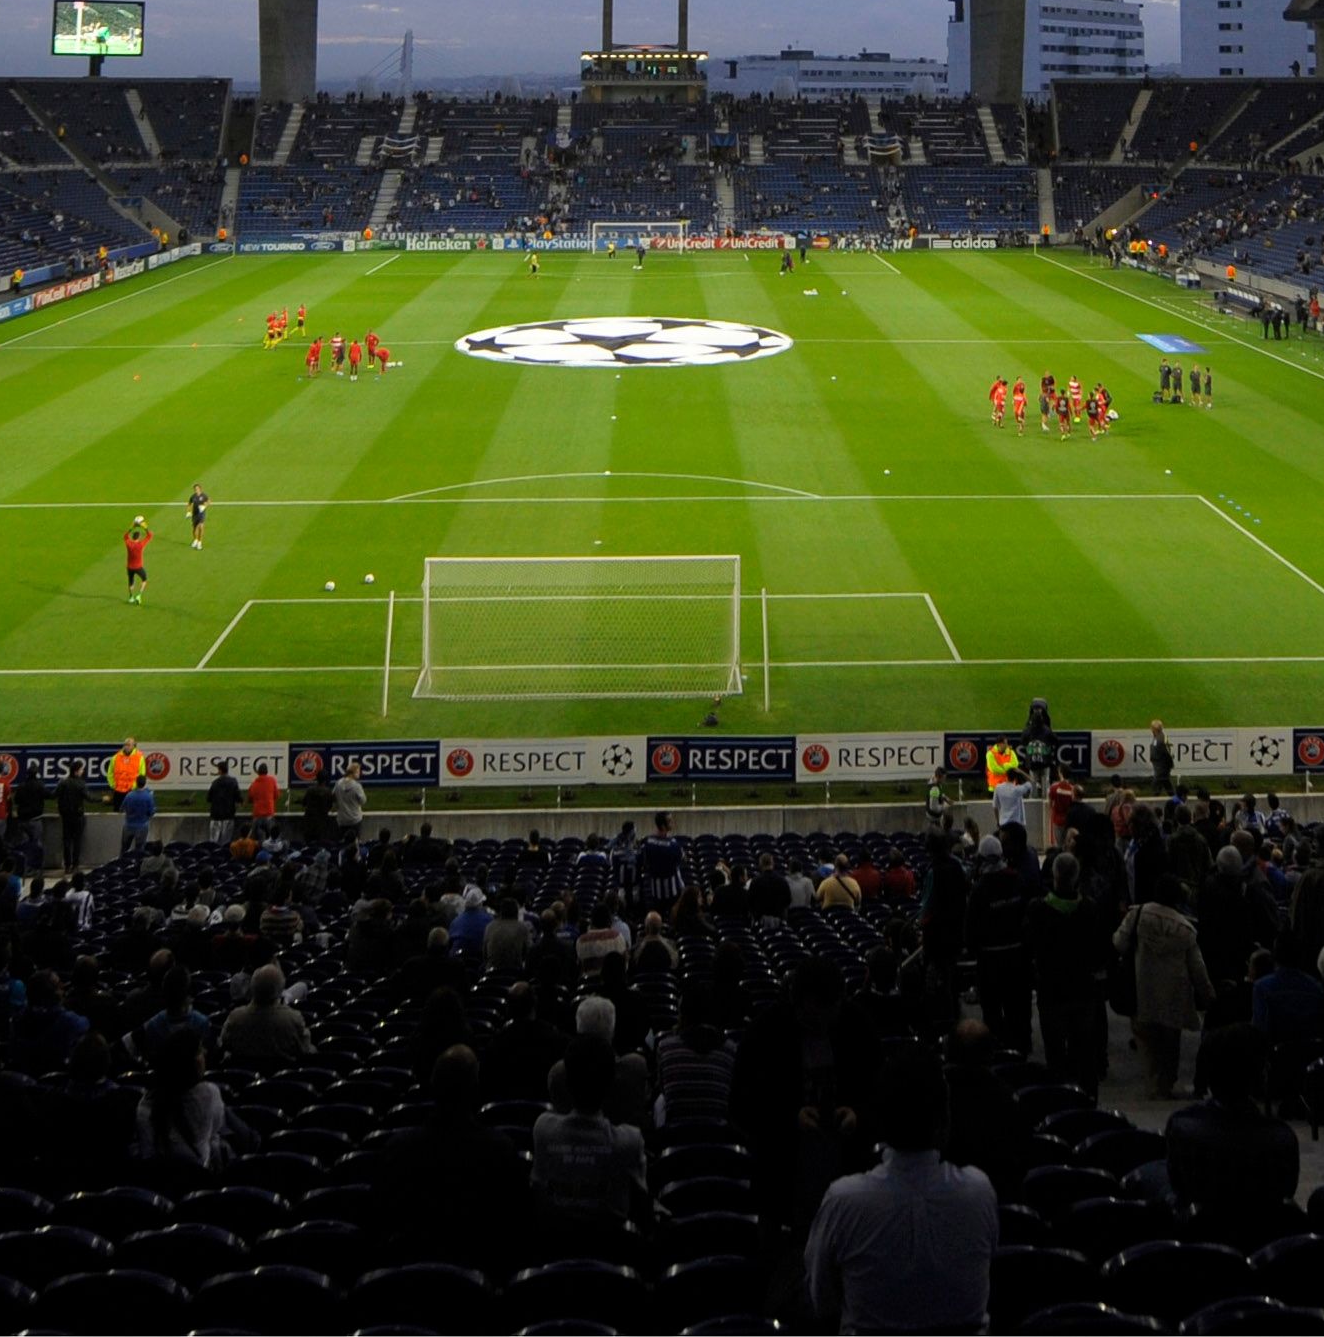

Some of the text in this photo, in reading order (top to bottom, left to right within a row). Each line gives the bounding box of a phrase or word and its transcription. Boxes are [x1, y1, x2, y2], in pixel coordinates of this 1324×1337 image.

[406, 237, 470, 251] Heineken
[731, 237, 779, 249] UniCredit
[953, 237, 997, 249] adidas
[483, 751, 586, 772] RESPECT
[689, 748, 792, 770] RESPECT
[838, 746, 940, 768] RESPECT
